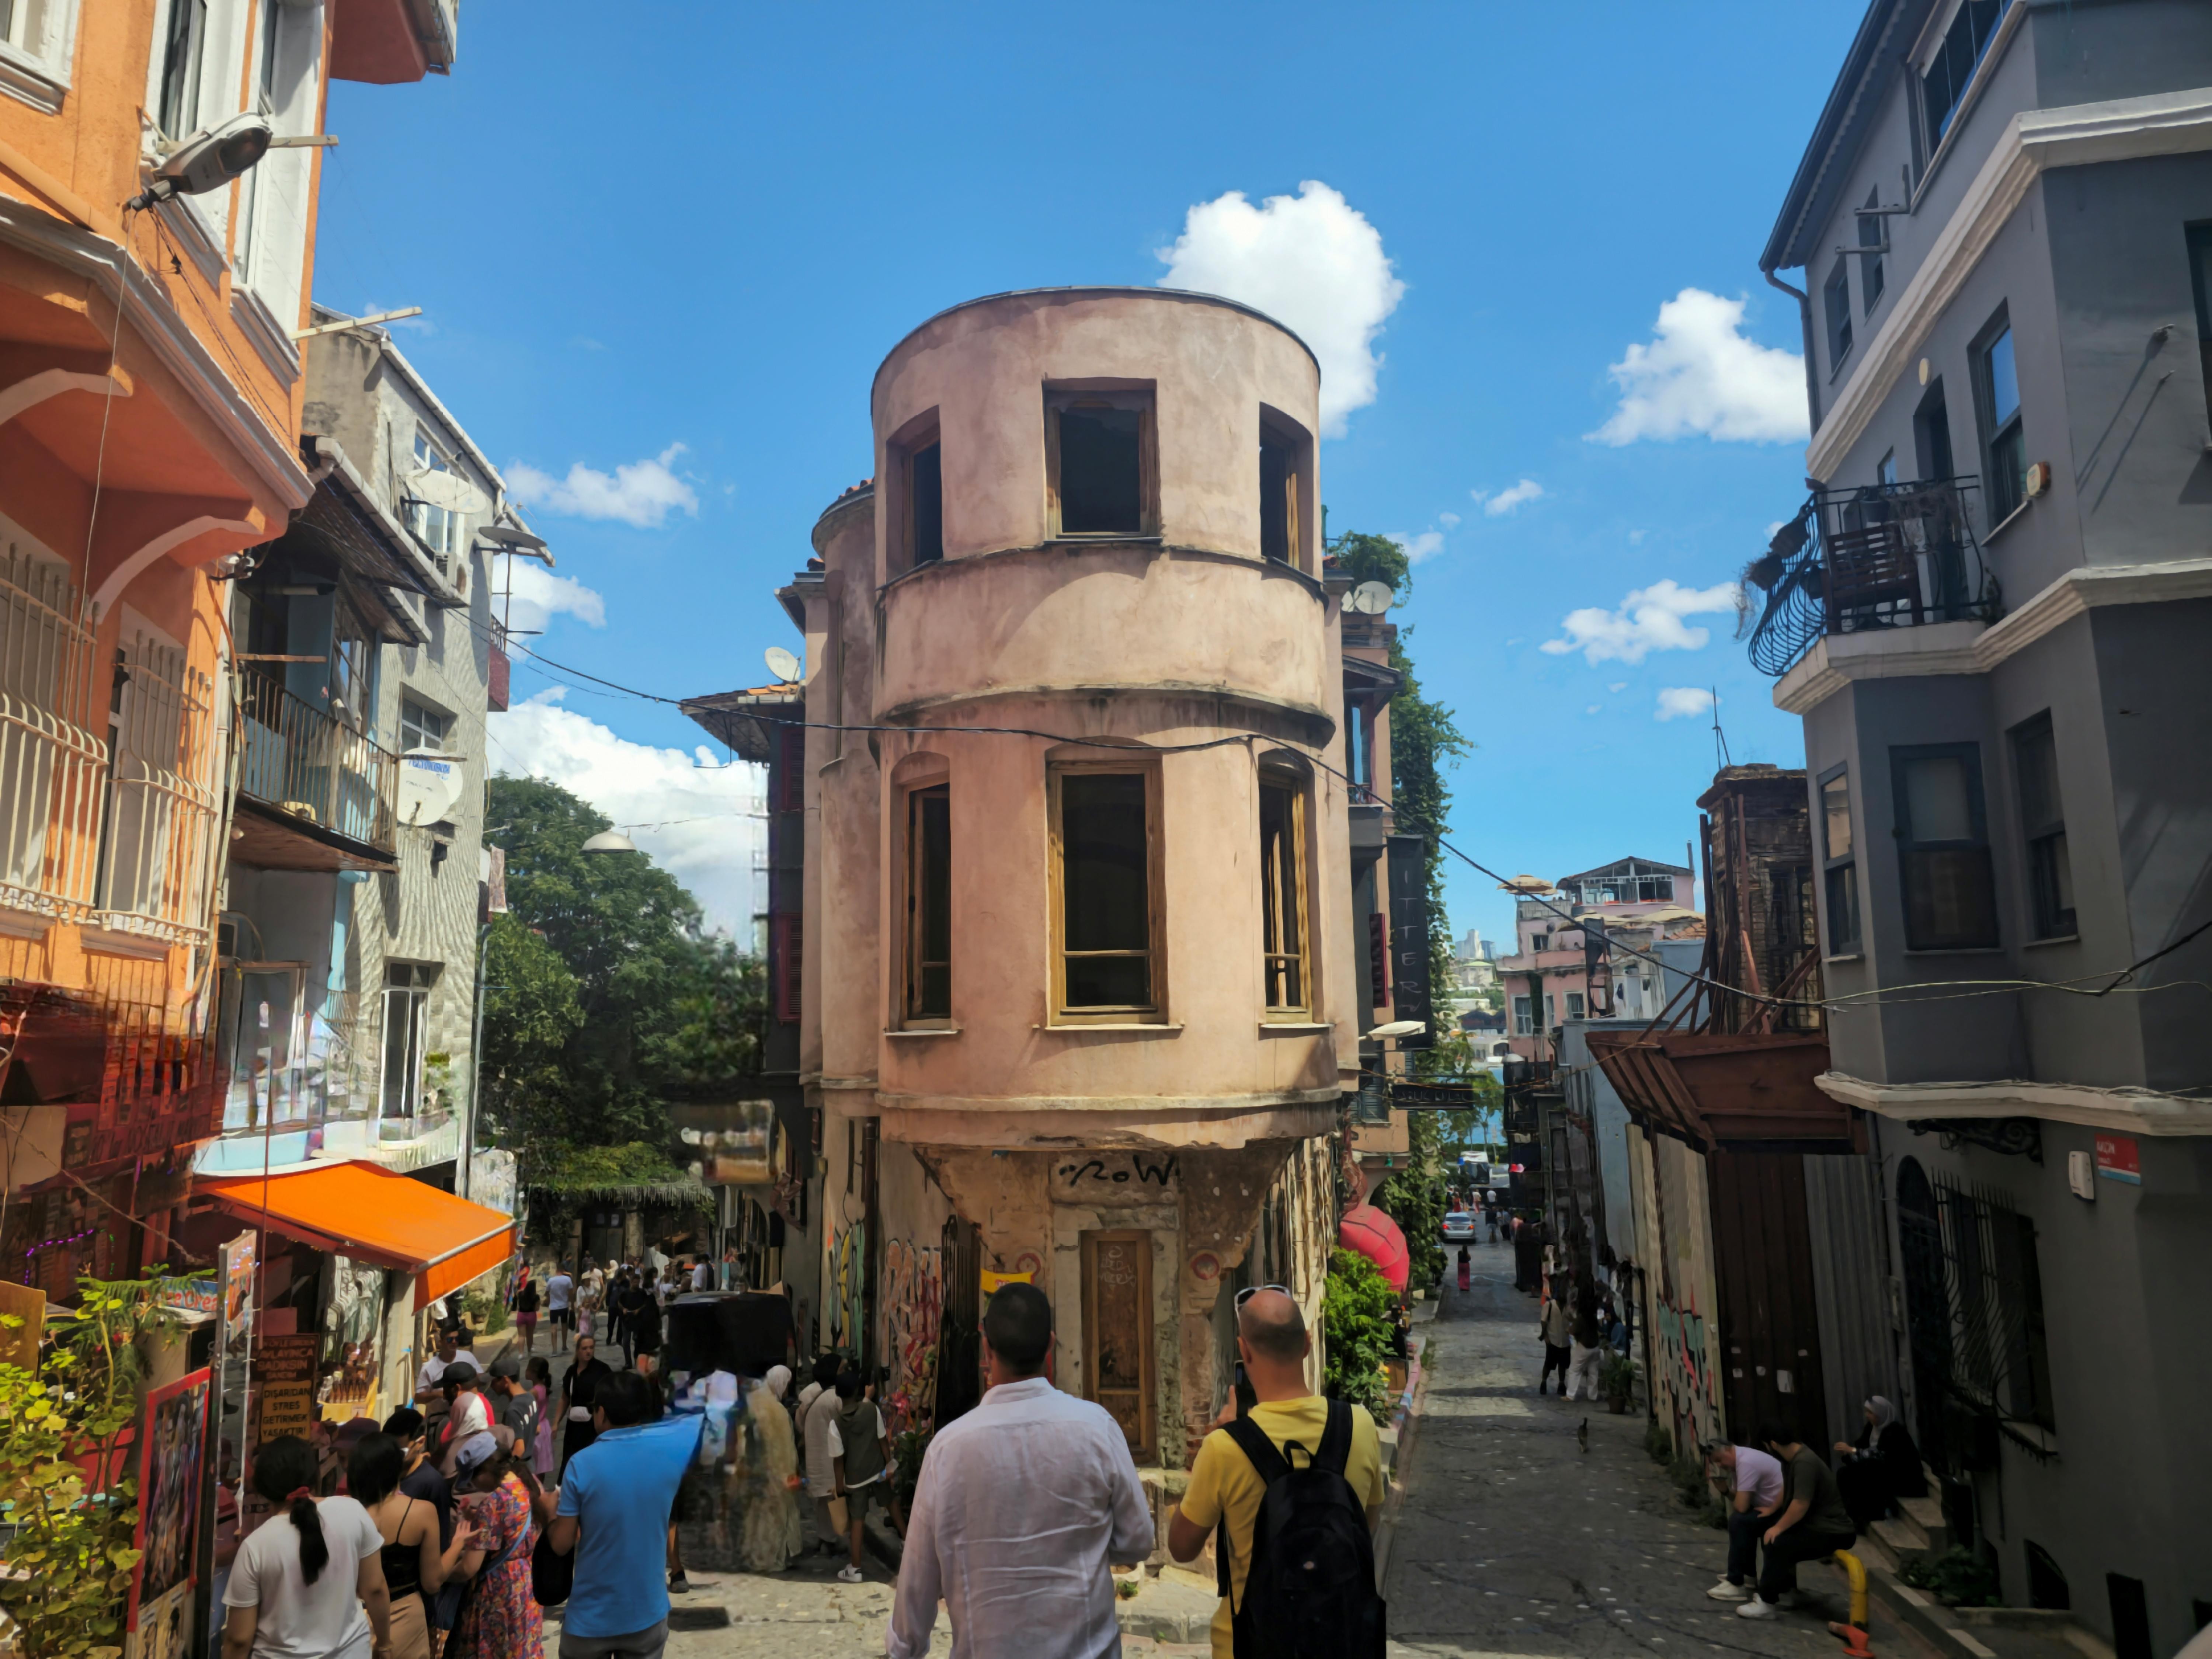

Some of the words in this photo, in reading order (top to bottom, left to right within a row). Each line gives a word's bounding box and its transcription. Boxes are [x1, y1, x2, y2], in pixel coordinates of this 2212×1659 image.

[184, 1290, 218, 1312] Crea
[257, 1347, 313, 1359] AVLAYINCA
[273, 1401, 300, 1411] STRES
